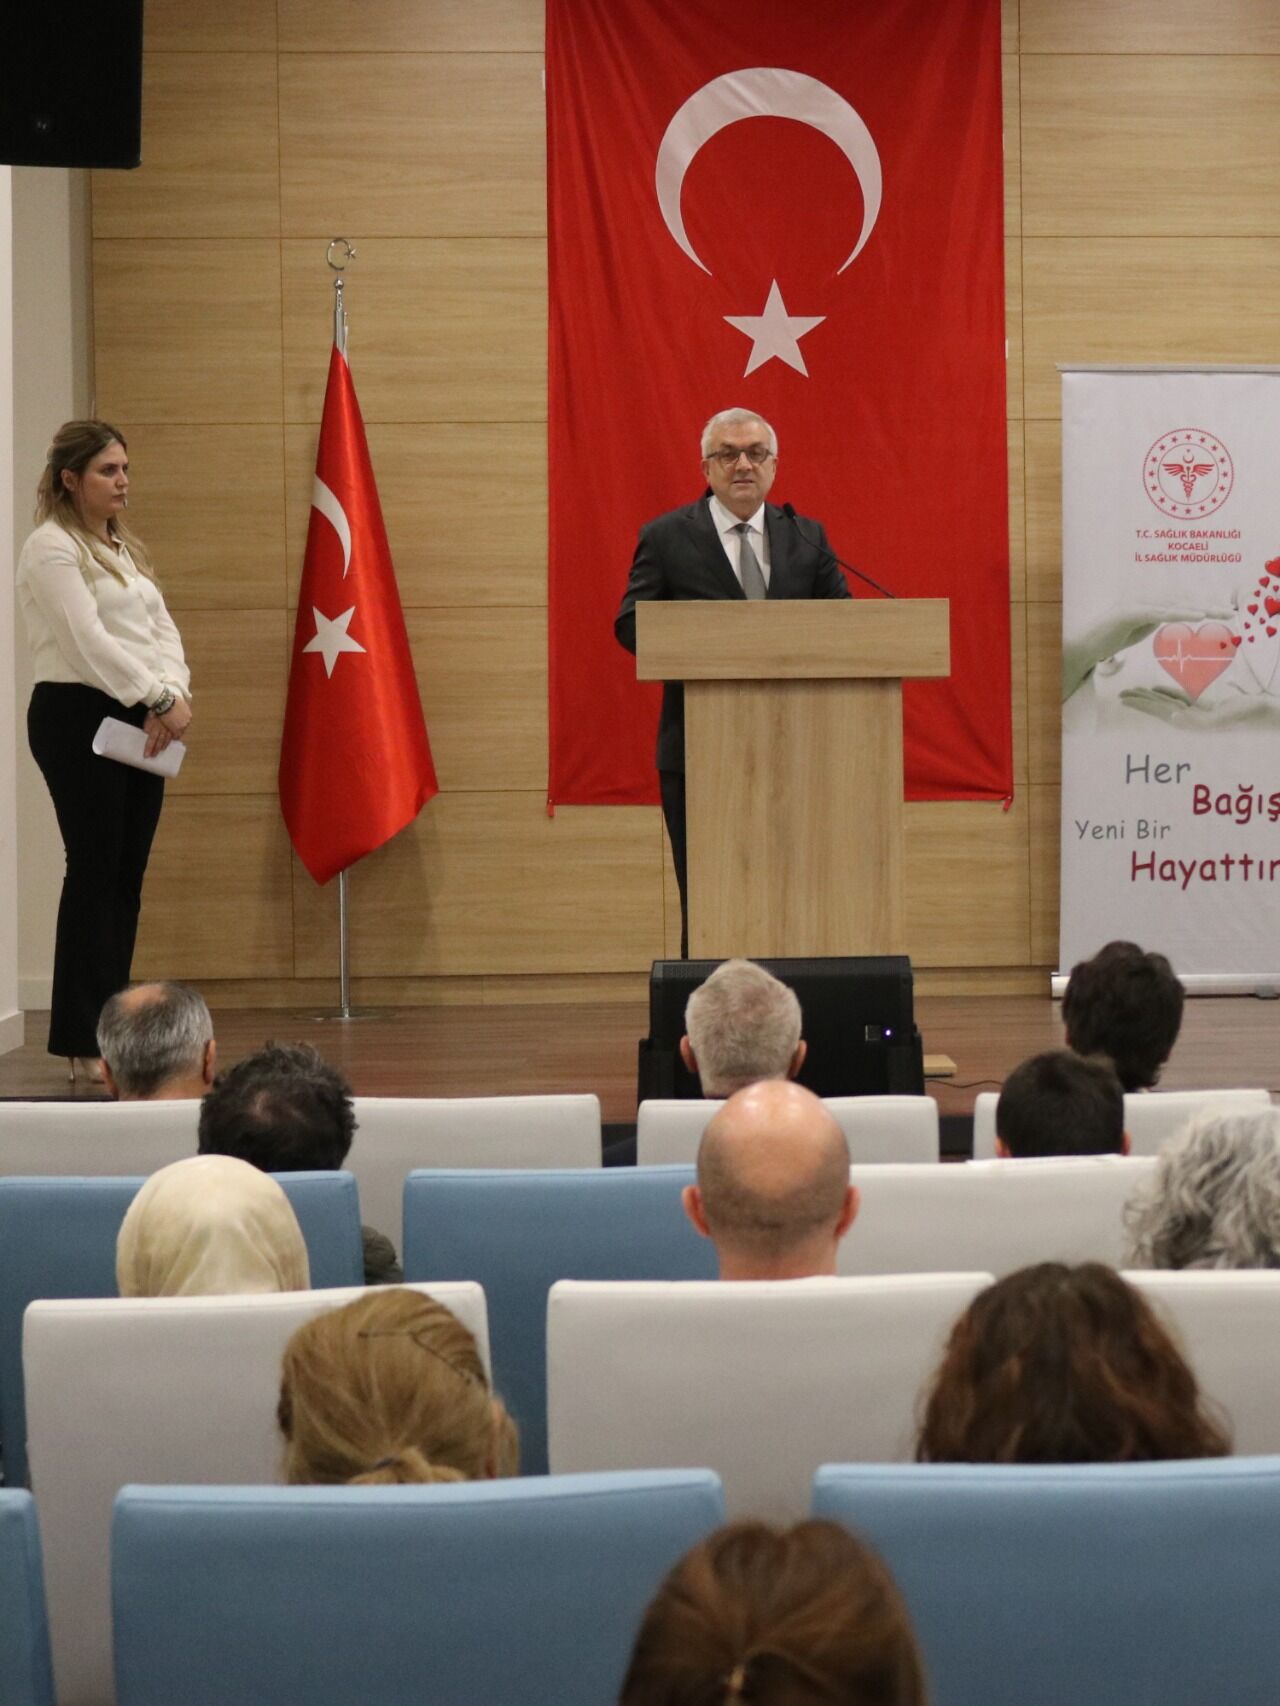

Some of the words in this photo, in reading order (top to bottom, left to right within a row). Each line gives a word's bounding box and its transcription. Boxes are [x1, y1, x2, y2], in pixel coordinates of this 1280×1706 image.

[1136, 530, 1152, 539] T.C.
[1154, 528, 1187, 539] SAĞLIK
[1189, 528, 1241, 539] BAKANLIĞI
[1168, 540, 1209, 551] KOCAELİ
[1135, 552, 1143, 562] İL
[1144, 552, 1178, 563] SAĞLIK
[1180, 552, 1242, 563] MÜDÜRLÜĞÜ
[1125, 754, 1191, 784] Her
[1074, 819, 1126, 840] Yeni
[1136, 819, 1171, 840] Bir
